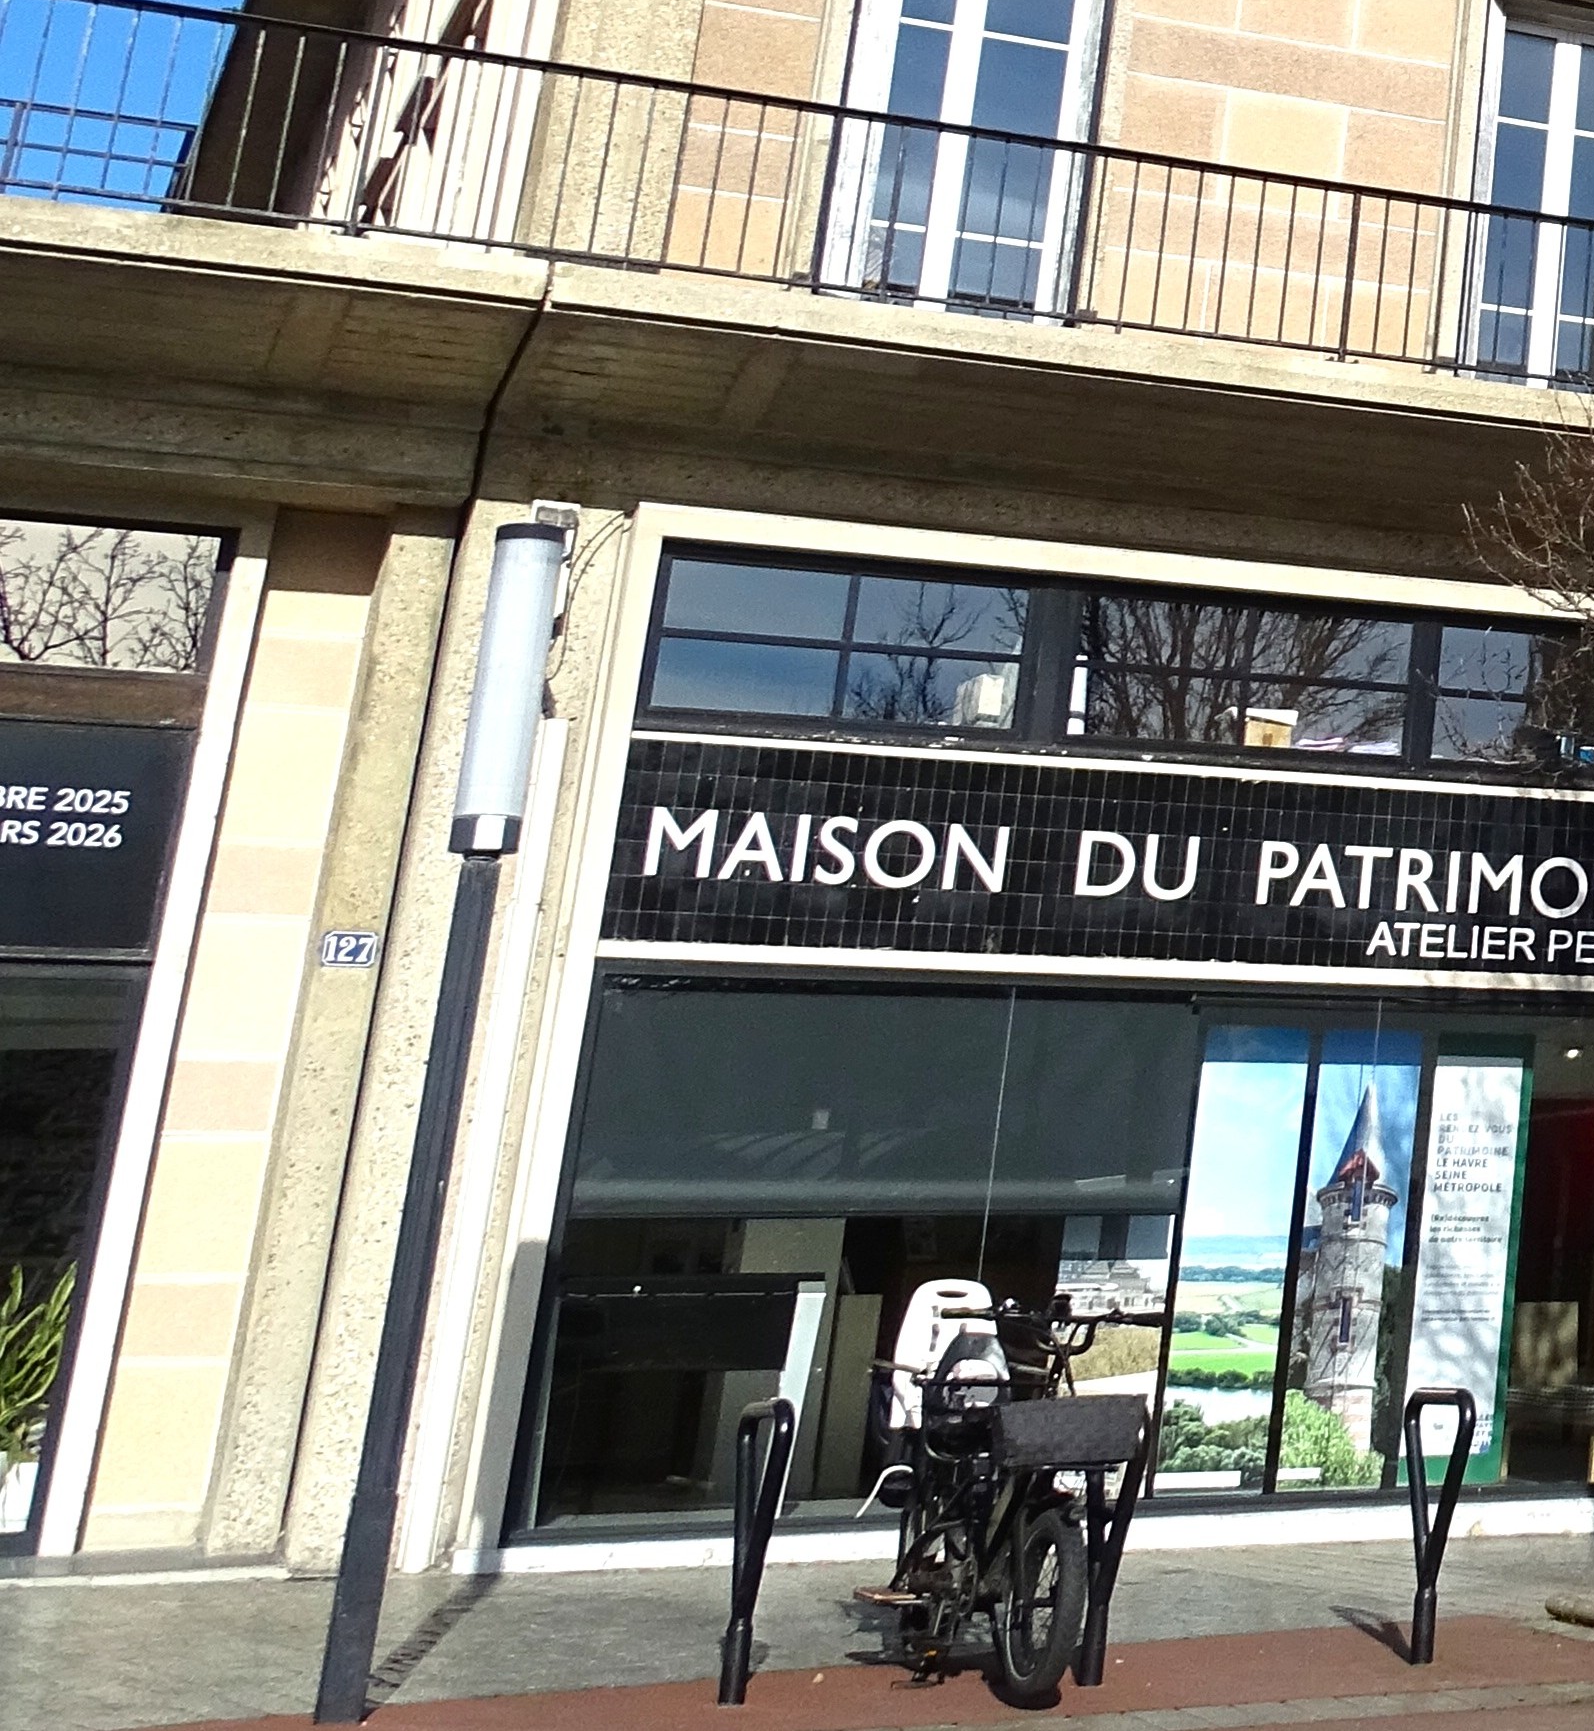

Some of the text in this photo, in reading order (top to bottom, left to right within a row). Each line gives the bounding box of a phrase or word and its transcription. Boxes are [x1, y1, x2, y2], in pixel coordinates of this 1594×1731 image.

[53, 787, 131, 814] 2025
[46, 821, 123, 848] 2026
[642, 806, 1011, 893] MAISON
[1073, 829, 1201, 901] DU
[1366, 921, 1535, 961] ATELIER
[325, 935, 375, 963] 127
[1440, 1113, 1458, 1122] LES
[1438, 1134, 1454, 1144] DU
[1437, 1145, 1509, 1156] PATRIMOINE
[1436, 1158, 1488, 1168] LE HAVRE
[1435, 1170, 1467, 1180] SEINE
[1433, 1181, 1502, 1193] MÉTROPOLE
